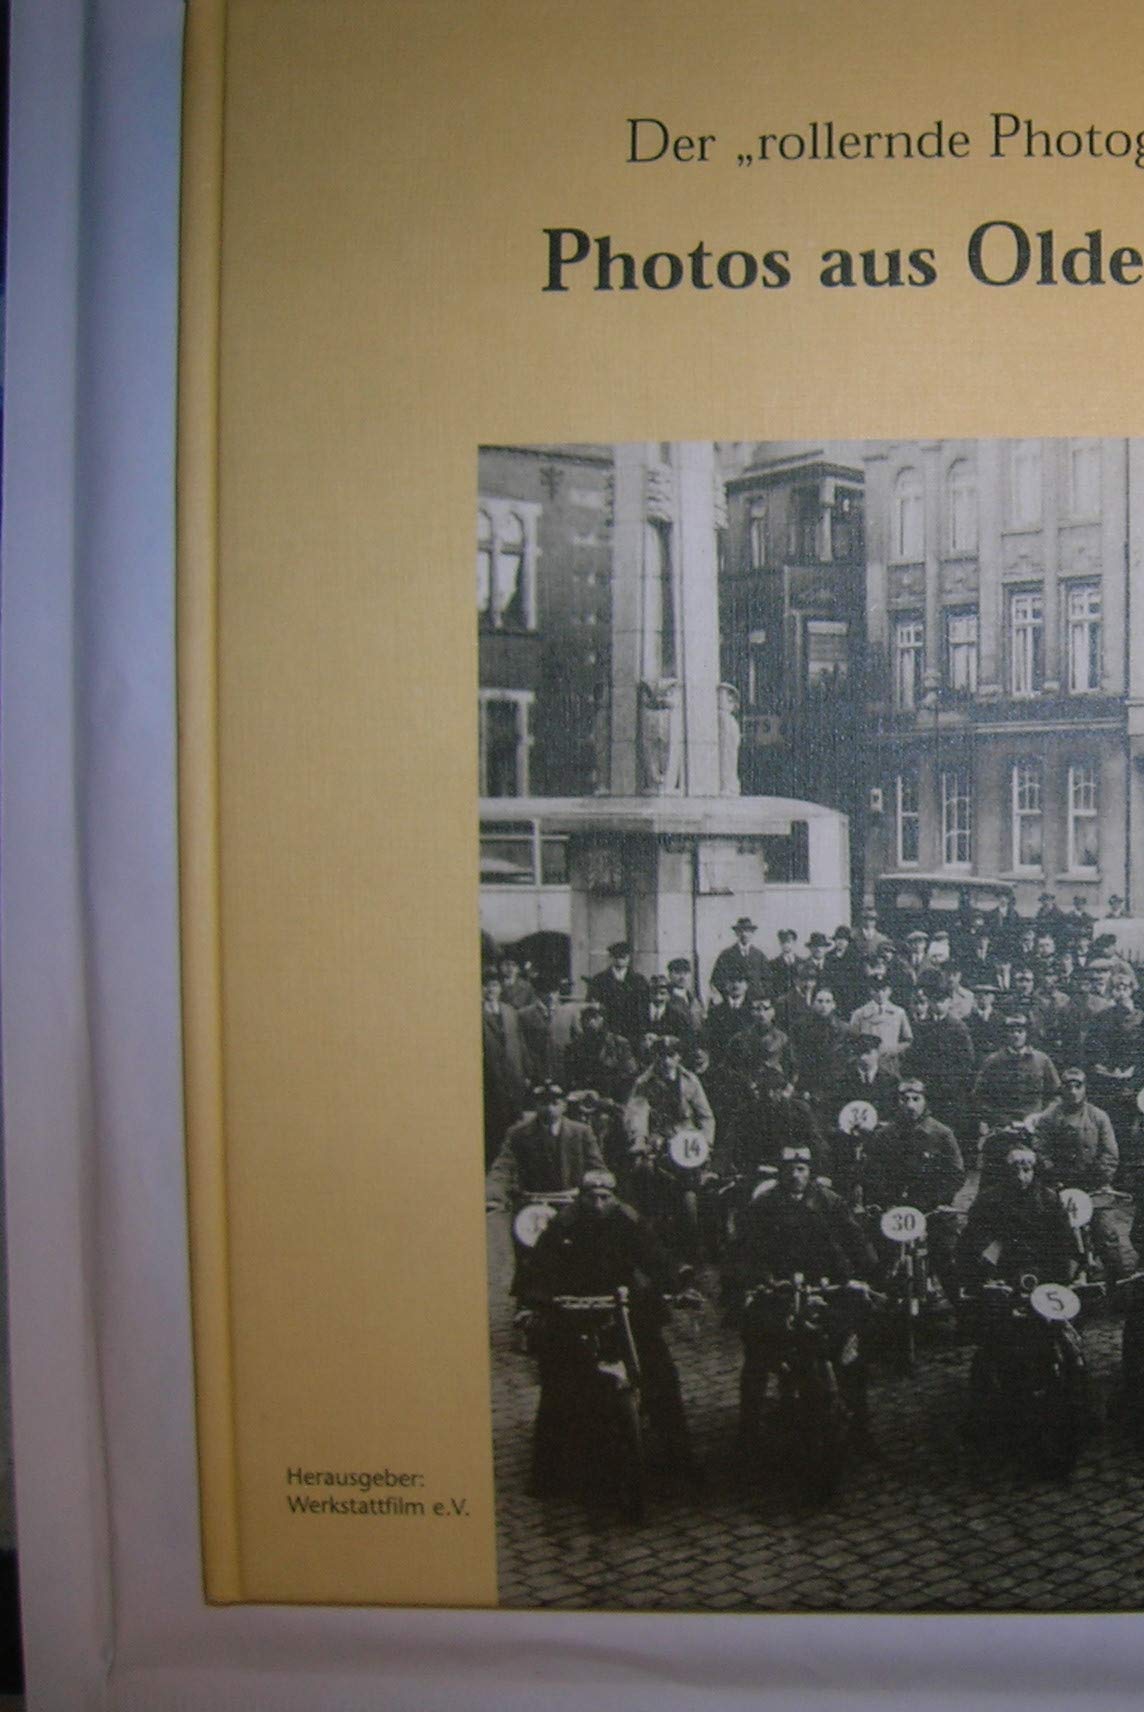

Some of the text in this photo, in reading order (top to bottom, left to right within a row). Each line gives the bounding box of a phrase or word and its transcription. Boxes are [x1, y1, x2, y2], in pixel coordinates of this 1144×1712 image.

[626, 117, 716, 164] Der
[737, 120, 970, 168] „rollernde
[541, 226, 792, 292] Photos
[819, 244, 938, 288] aus
[891, 1213, 916, 1232] 30
[1045, 1291, 1064, 1312] 5
[286, 1467, 425, 1491] Herausgeber:
[286, 1495, 470, 1516] Werkstattfilm e.V.
